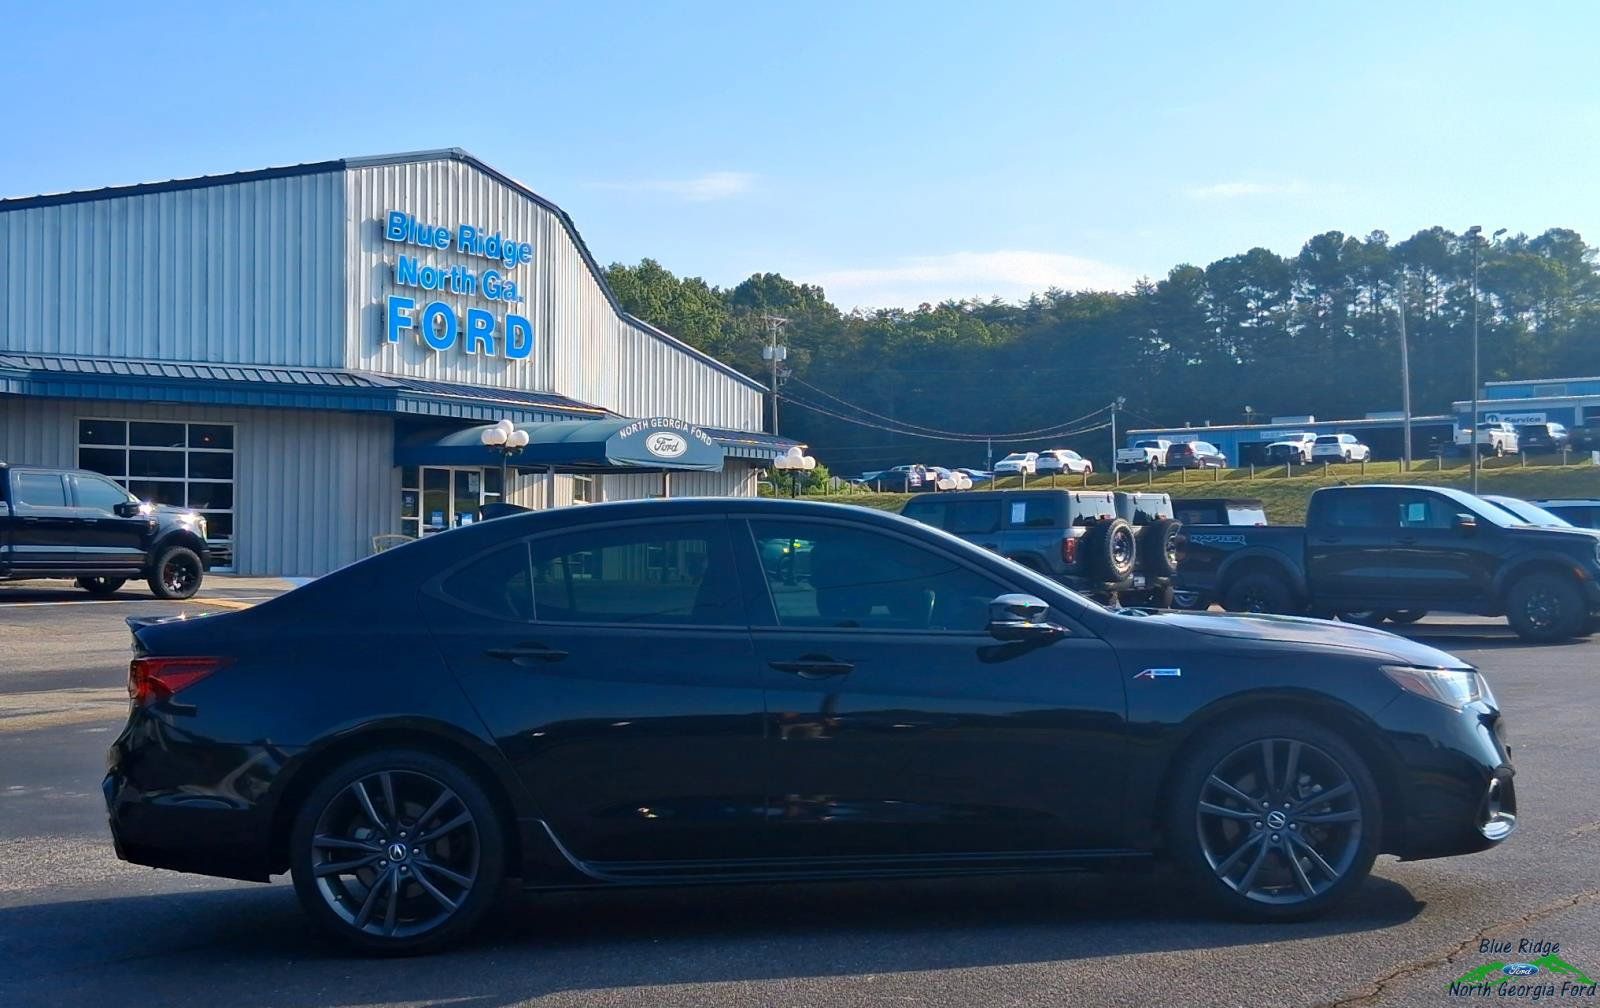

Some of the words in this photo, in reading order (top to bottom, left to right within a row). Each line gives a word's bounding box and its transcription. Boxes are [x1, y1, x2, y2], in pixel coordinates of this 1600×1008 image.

[386, 210, 451, 250] Blue
[457, 224, 534, 269] Ridge
[397, 254, 476, 296] North
[387, 295, 534, 360] FORD
[620, 419, 648, 439] NORTH
[651, 418, 688, 433] GEORGIA
[691, 426, 712, 446] FORD
[1504, 416, 1542, 424] Service
[654, 437, 678, 452] Ford
